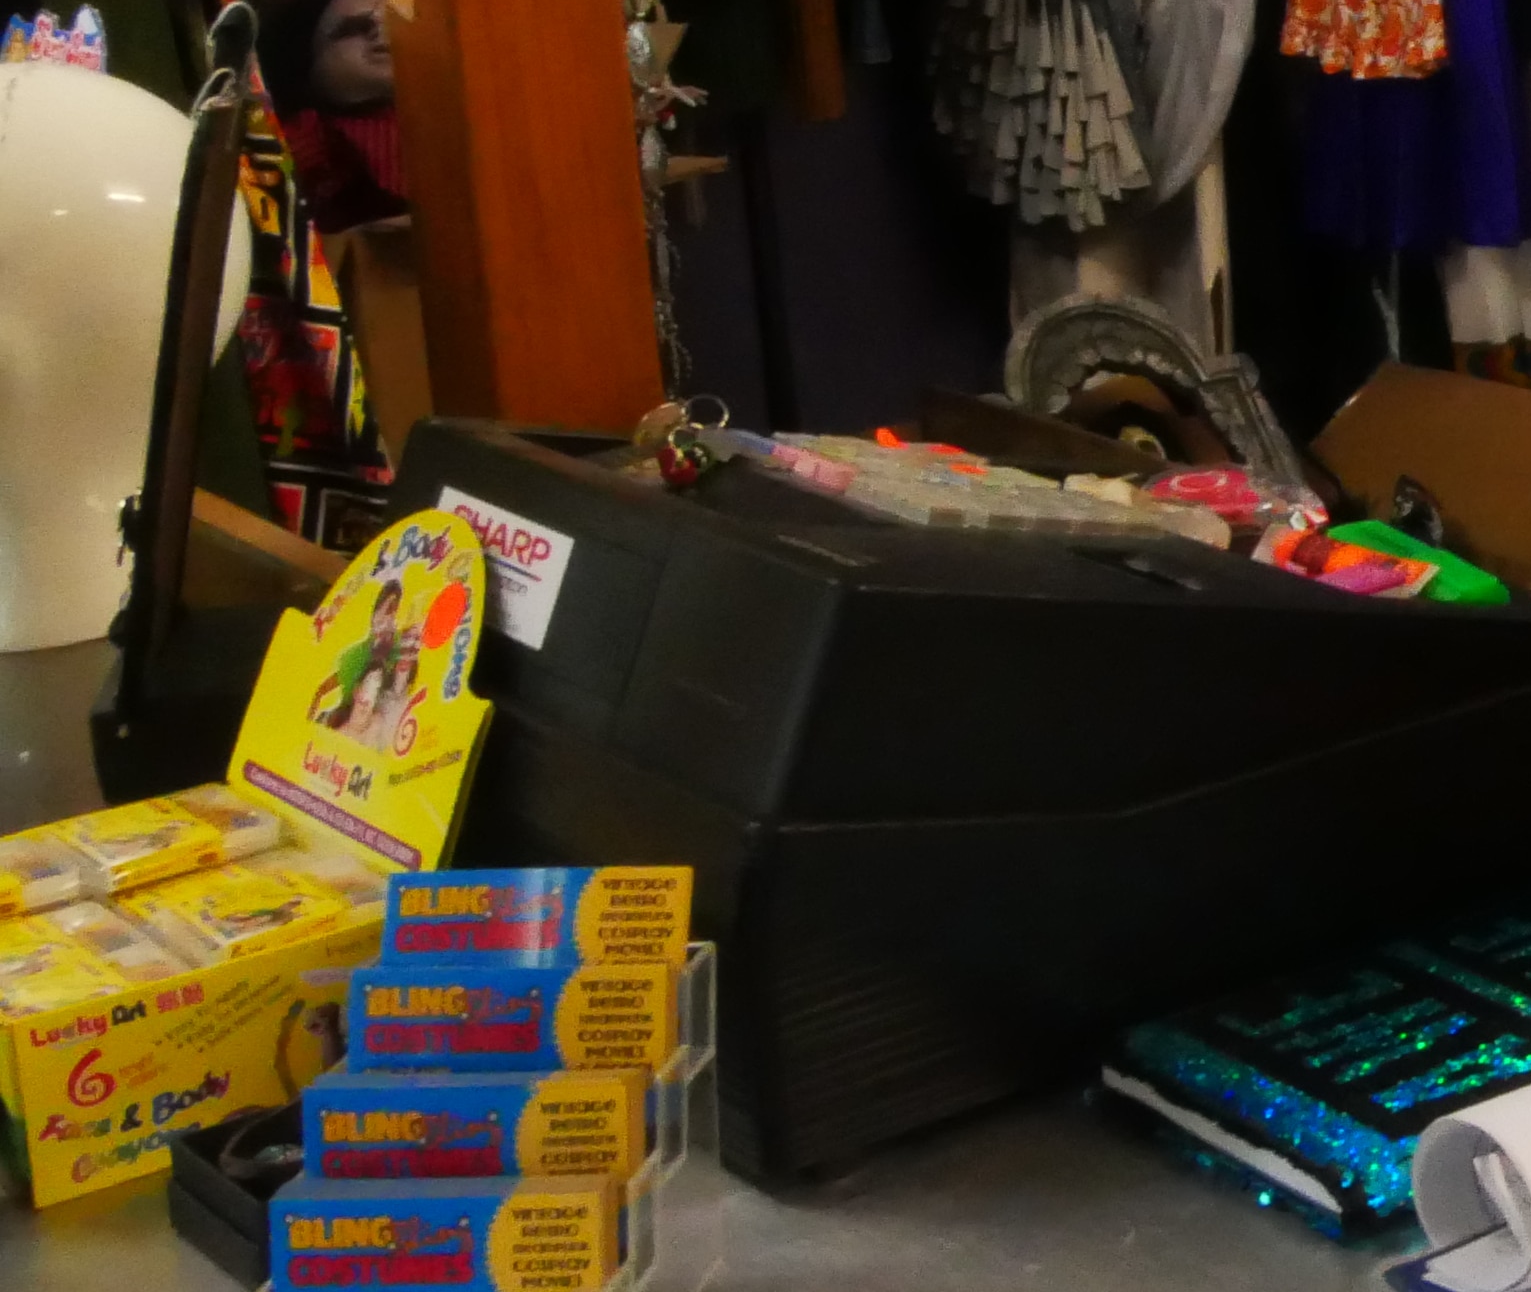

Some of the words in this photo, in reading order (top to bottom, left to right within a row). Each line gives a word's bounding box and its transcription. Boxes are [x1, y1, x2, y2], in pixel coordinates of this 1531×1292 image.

[400, 886, 491, 916] BLING
[396, 921, 560, 951] COSTUMES
[366, 987, 468, 1017] BLING
[365, 1022, 540, 1053] COSTUMES
[67, 1048, 117, 1108] 6
[151, 1070, 232, 1126] Body
[323, 1111, 428, 1143] BLING
[321, 1148, 503, 1179] COSTUMES
[289, 1217, 395, 1249] BLING
[288, 1254, 474, 1287] COSTUMES
